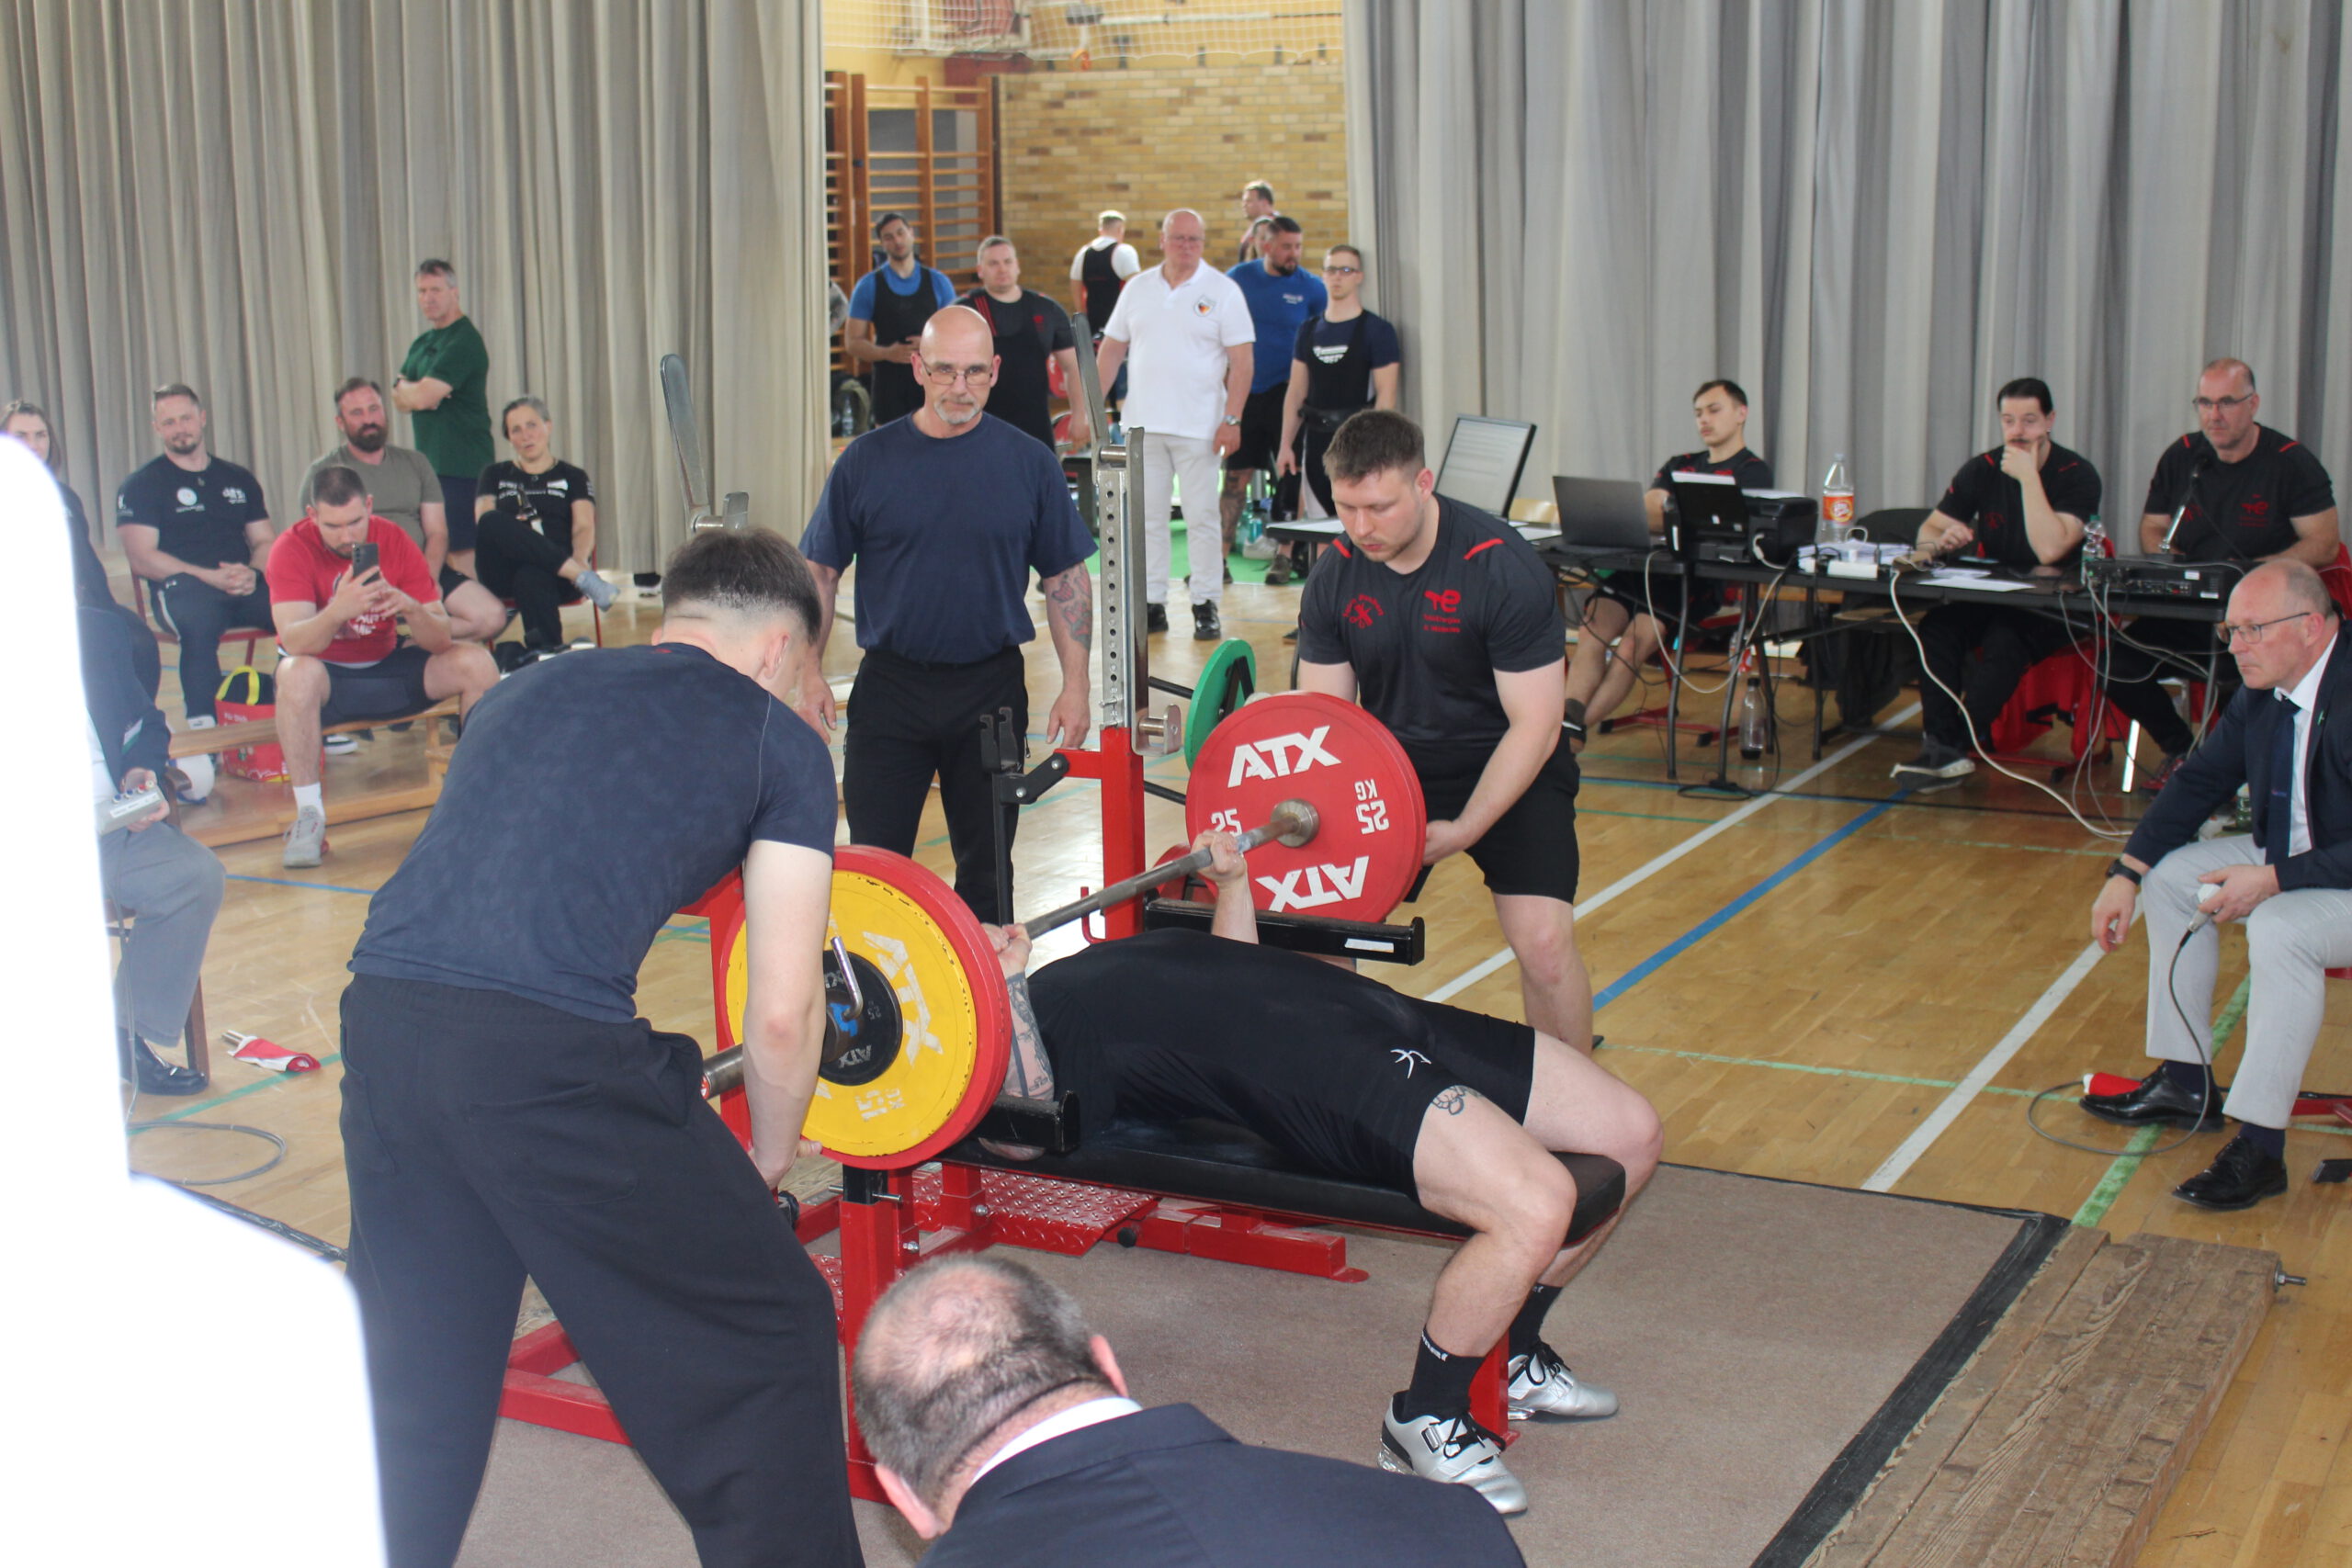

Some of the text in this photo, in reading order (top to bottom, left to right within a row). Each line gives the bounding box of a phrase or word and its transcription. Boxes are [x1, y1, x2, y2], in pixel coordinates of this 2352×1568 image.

[1227, 725, 1342, 788] ATX
[1354, 779, 1378, 801] KG
[1210, 808, 1243, 837] 25
[1355, 800, 1390, 835] 25
[1255, 855, 1370, 913] ATX
[862, 931, 944, 1067] ATX
[838, 1044, 872, 1069] ATX
